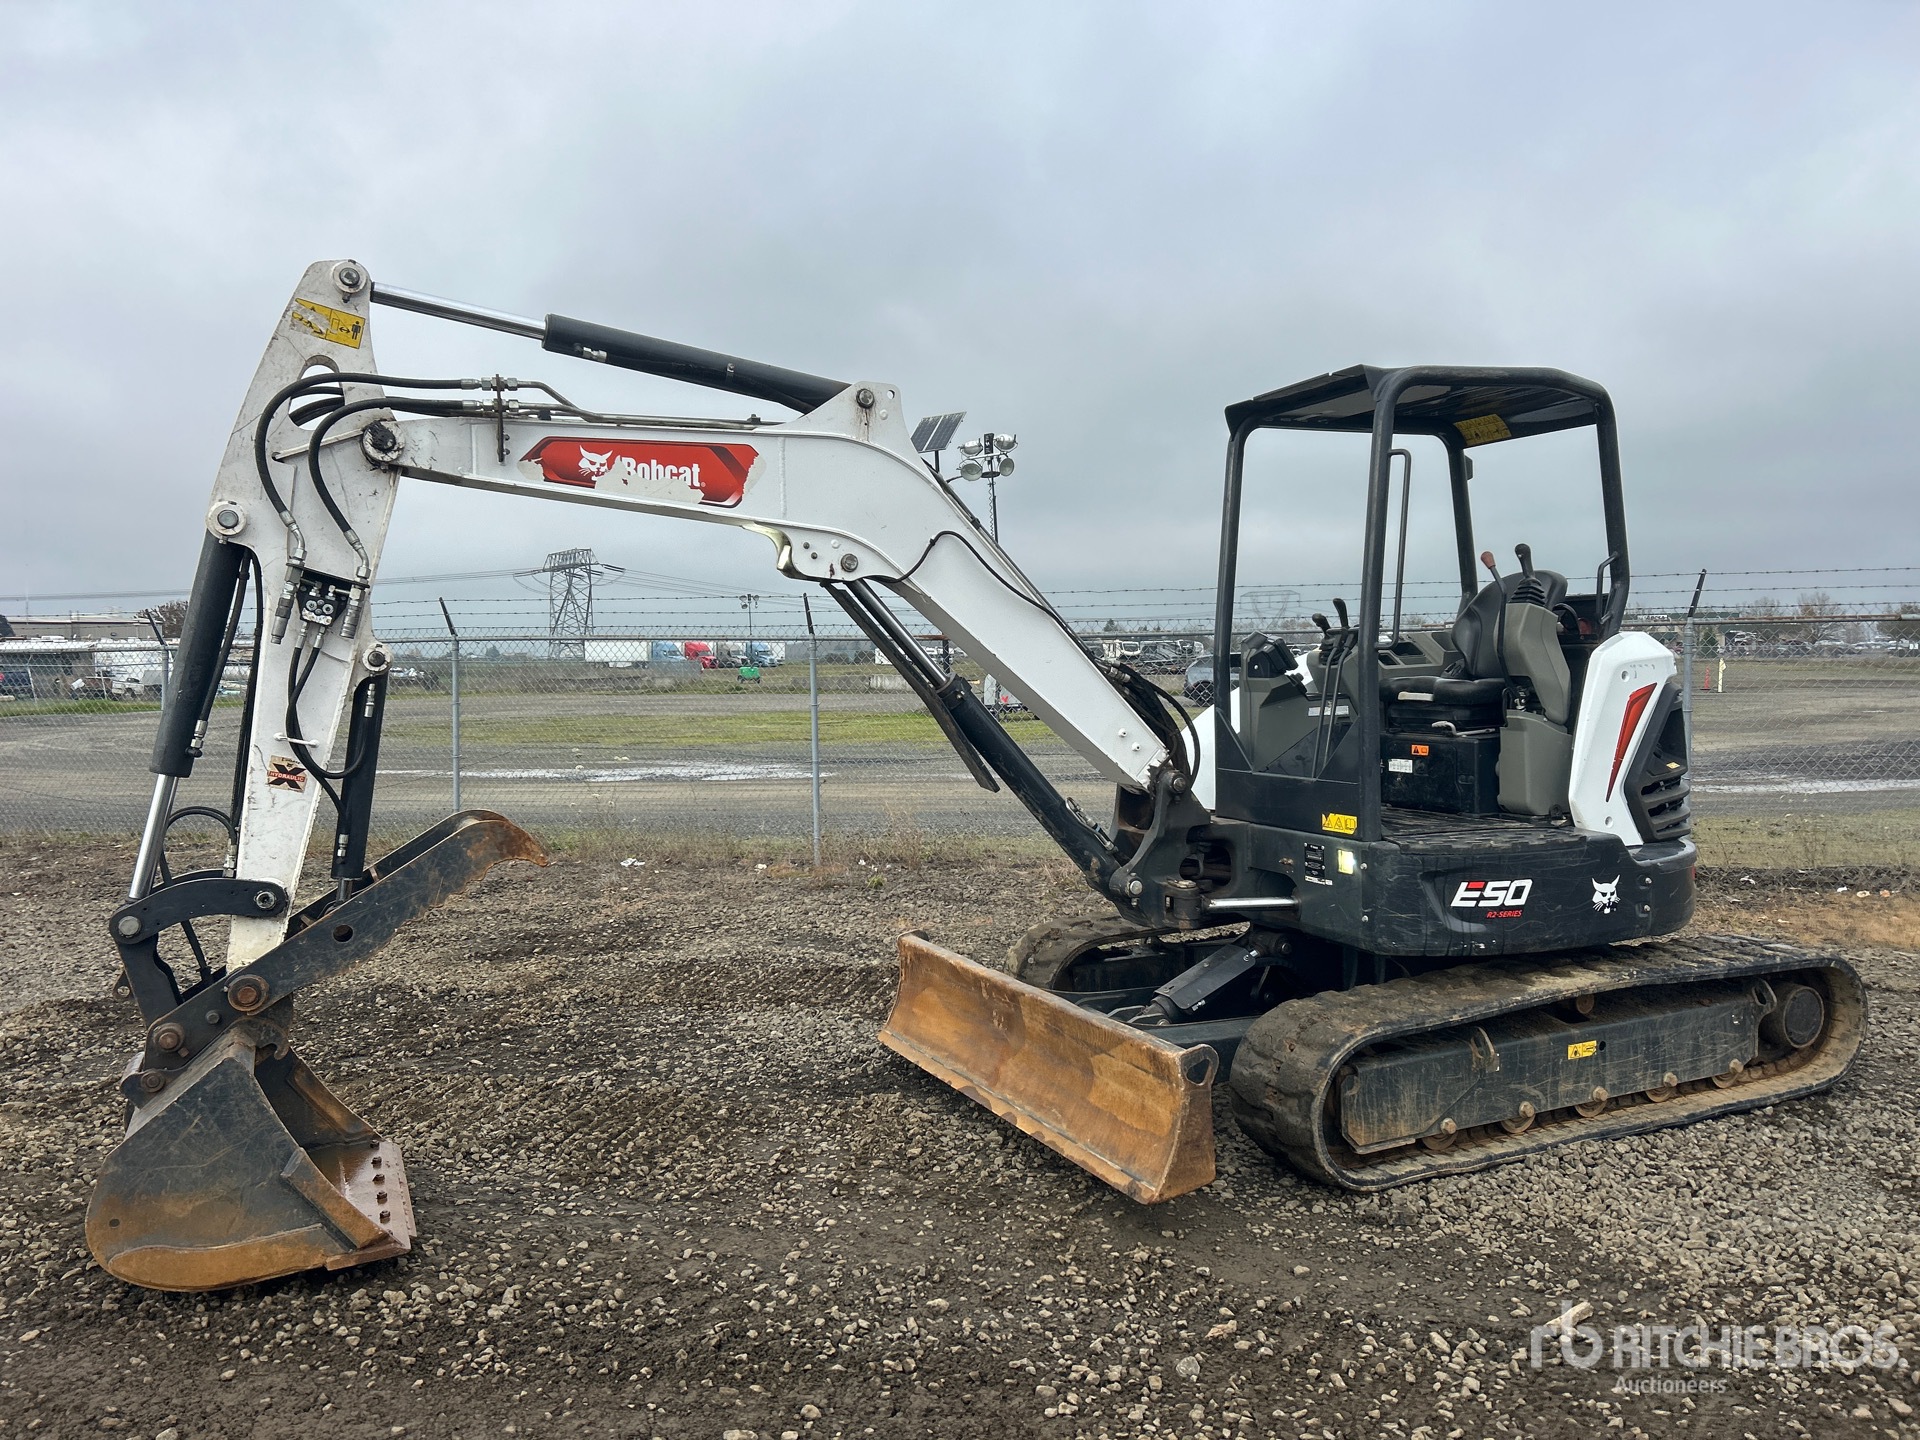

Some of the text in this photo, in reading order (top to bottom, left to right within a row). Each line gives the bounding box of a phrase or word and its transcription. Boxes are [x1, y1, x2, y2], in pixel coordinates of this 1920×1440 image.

[621, 457, 700, 487] Bobcat
[270, 772, 304, 782] HYDRAULIC
[1451, 879, 1533, 907] E50
[1486, 910, 1523, 918] R2-SERIES
